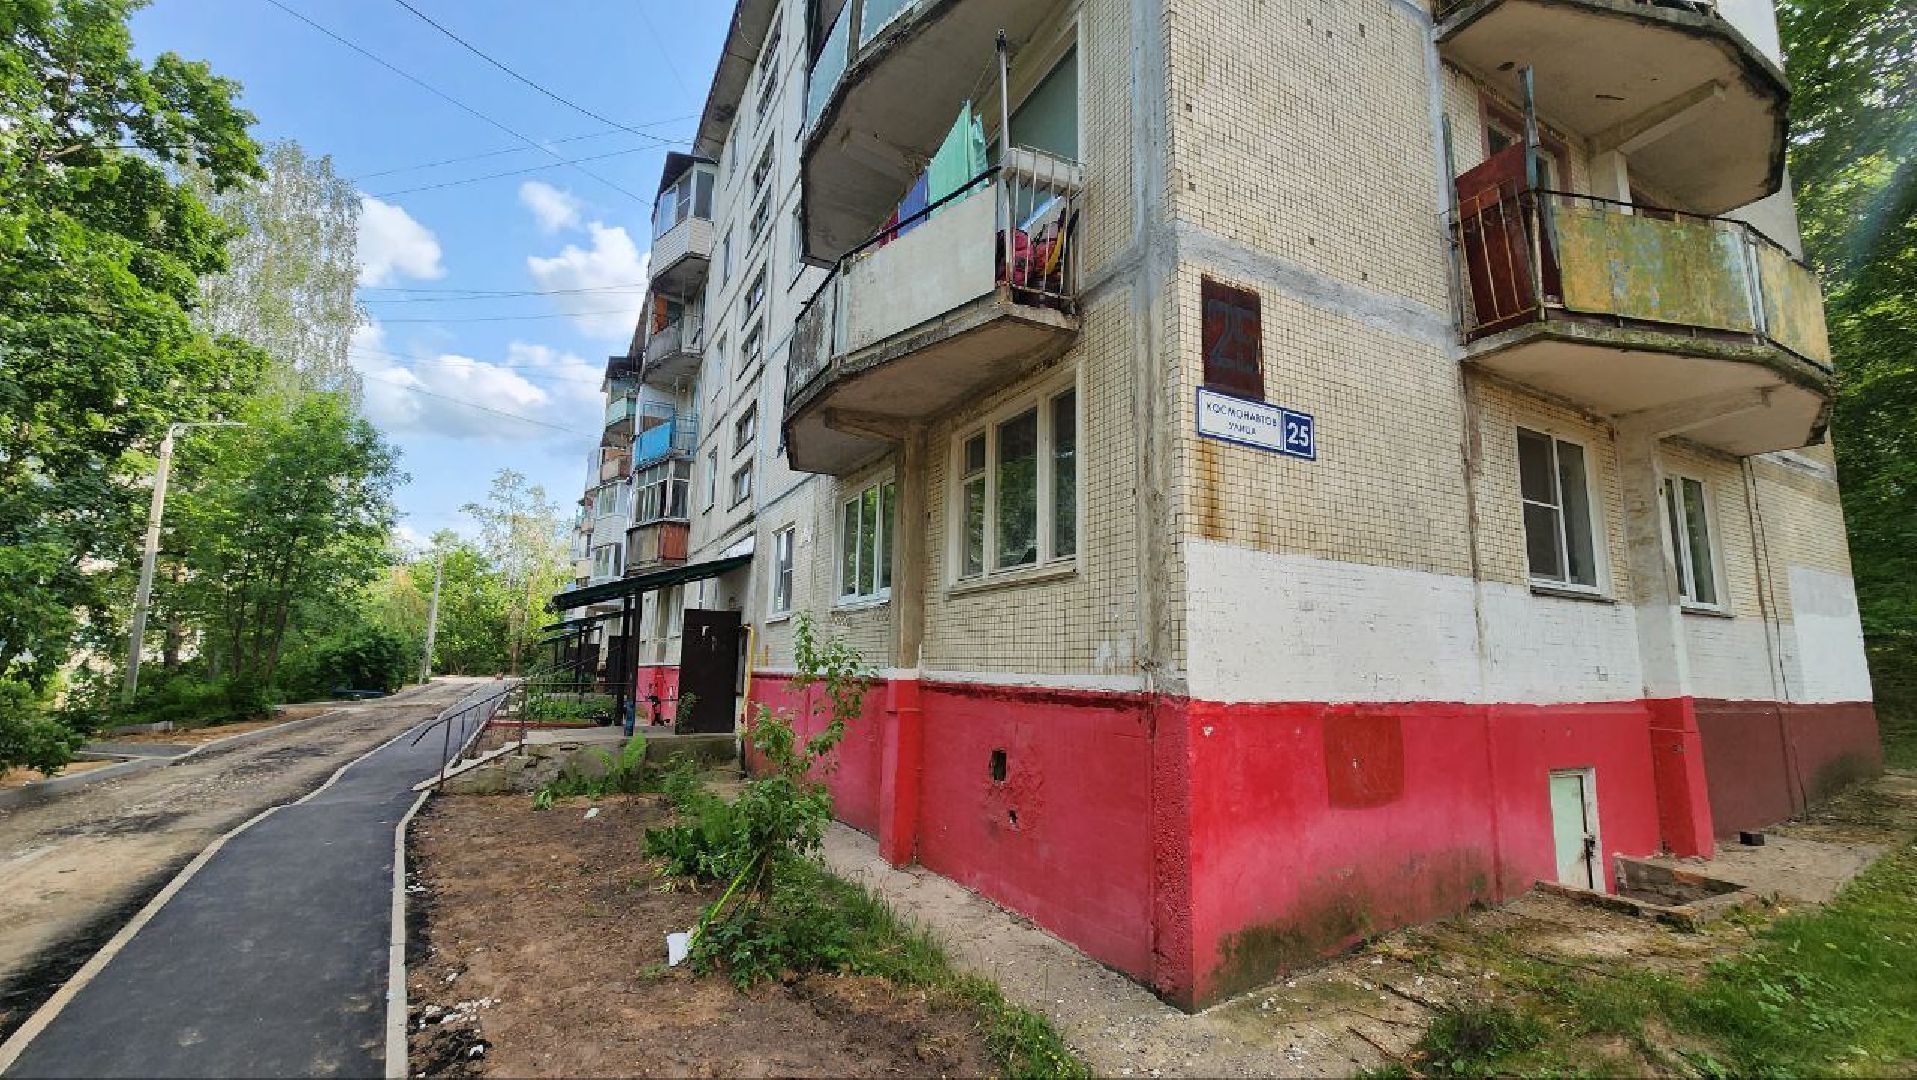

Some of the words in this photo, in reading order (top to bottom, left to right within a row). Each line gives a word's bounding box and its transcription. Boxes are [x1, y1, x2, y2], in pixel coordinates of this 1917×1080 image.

[1207, 300, 1257, 371] 25
[1206, 403, 1277, 427] КОСМОНАВТОВ
[1228, 421, 1256, 436] УЛИЦА
[1286, 422, 1309, 447] 25
